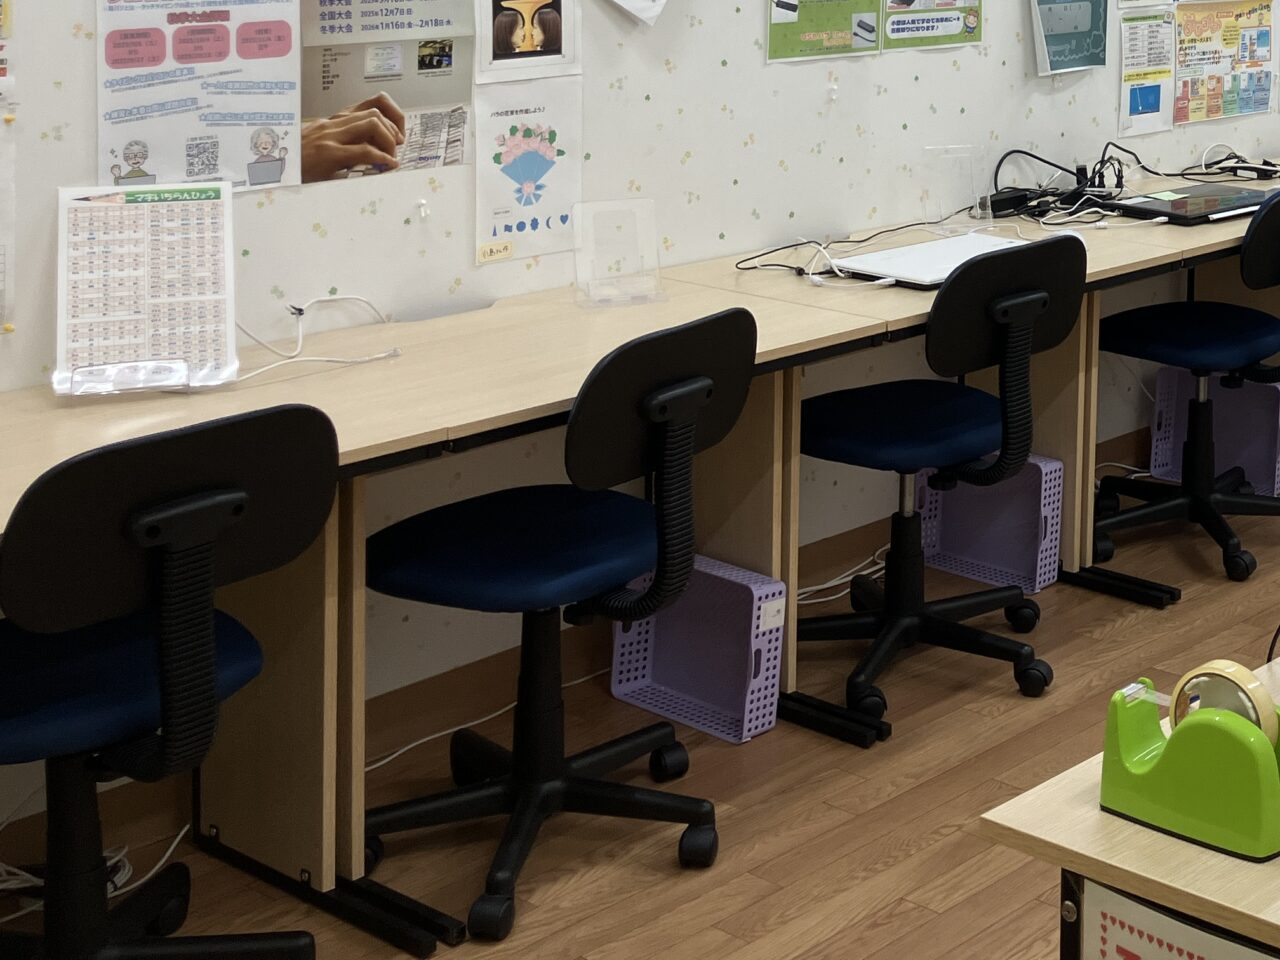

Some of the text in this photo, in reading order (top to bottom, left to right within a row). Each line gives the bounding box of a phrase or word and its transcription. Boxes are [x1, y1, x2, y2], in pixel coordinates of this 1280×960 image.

[320, 11, 352, 21] 全国大会
[320, 25, 352, 34] 冬季大会
